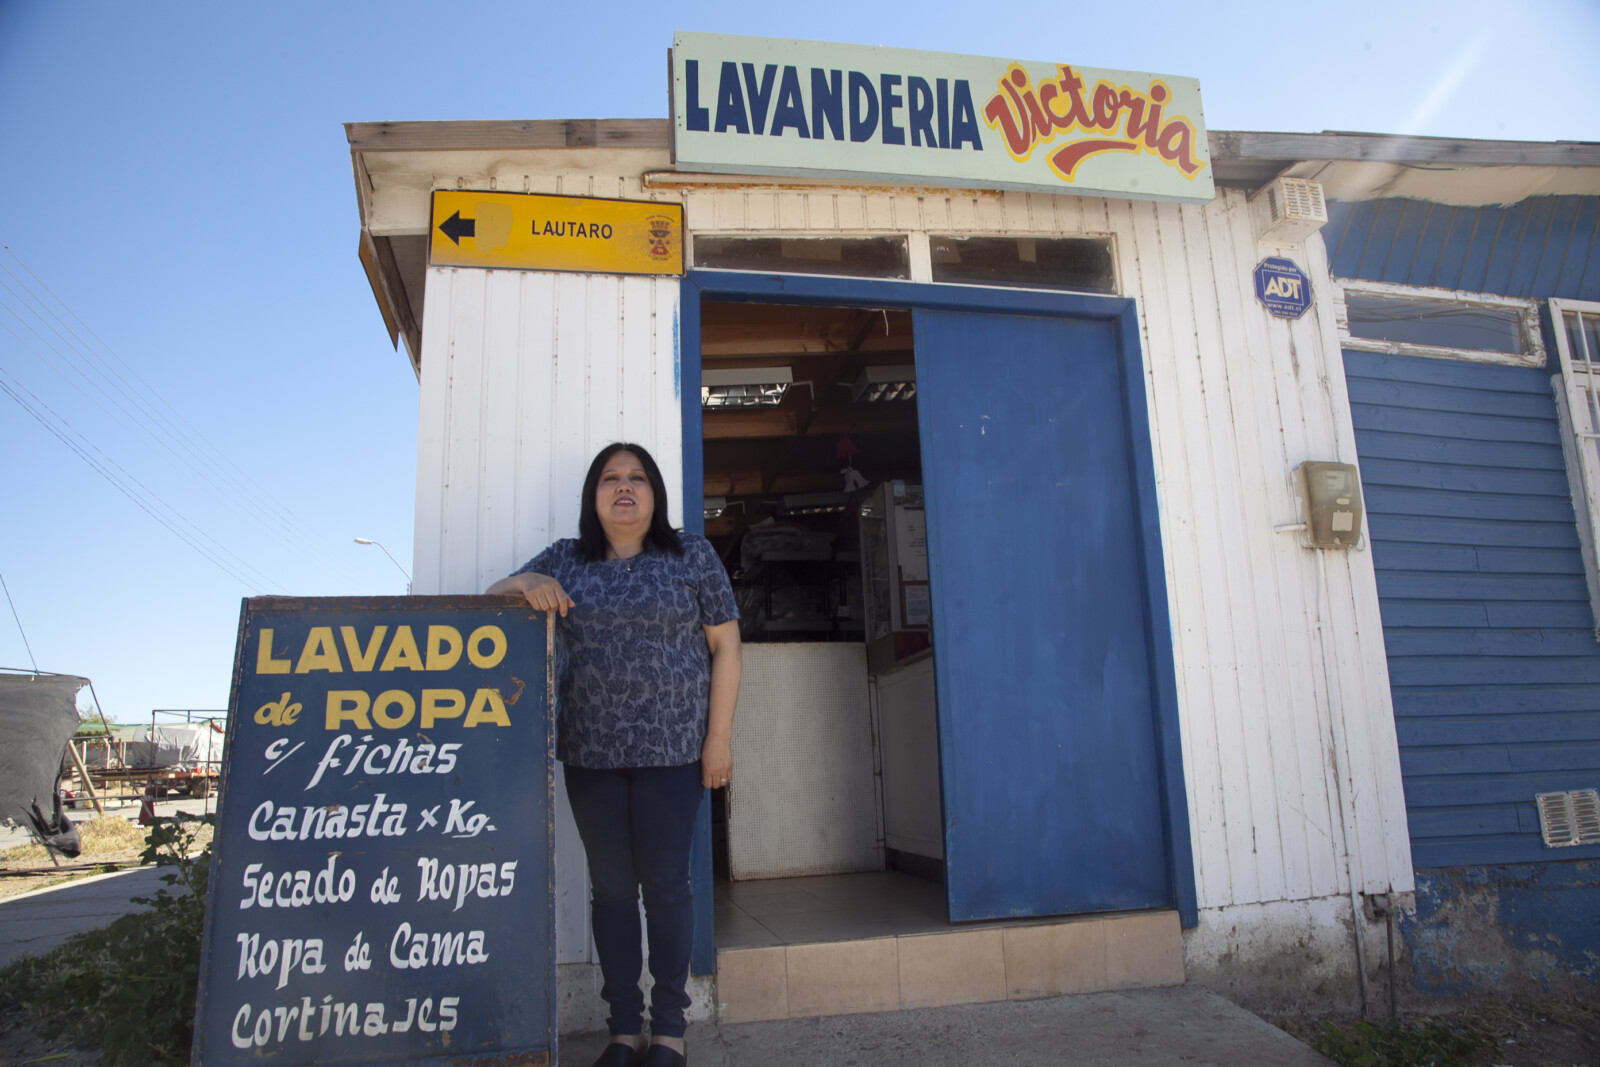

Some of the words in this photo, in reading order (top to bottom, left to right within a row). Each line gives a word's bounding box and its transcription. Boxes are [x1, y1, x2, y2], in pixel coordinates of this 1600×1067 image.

[685, 59, 984, 151] LAVANDERIA
[982, 62, 1205, 180] Victoria
[531, 220, 613, 239] LAUTARO
[1265, 276, 1301, 299] ADT
[255, 625, 508, 674] LAVADO
[253, 692, 303, 727] de
[325, 689, 511, 730] ROPA
[263, 738, 305, 775] c/
[304, 734, 462, 790] fichas
[248, 794, 407, 841] Canasta
[417, 805, 441, 832] x
[240, 855, 356, 909] Secado
[370, 867, 401, 905] de
[416, 856, 518, 912] Ropas
[237, 932, 326, 990] Ropa
[344, 931, 372, 972] de
[390, 922, 489, 969] Cama
